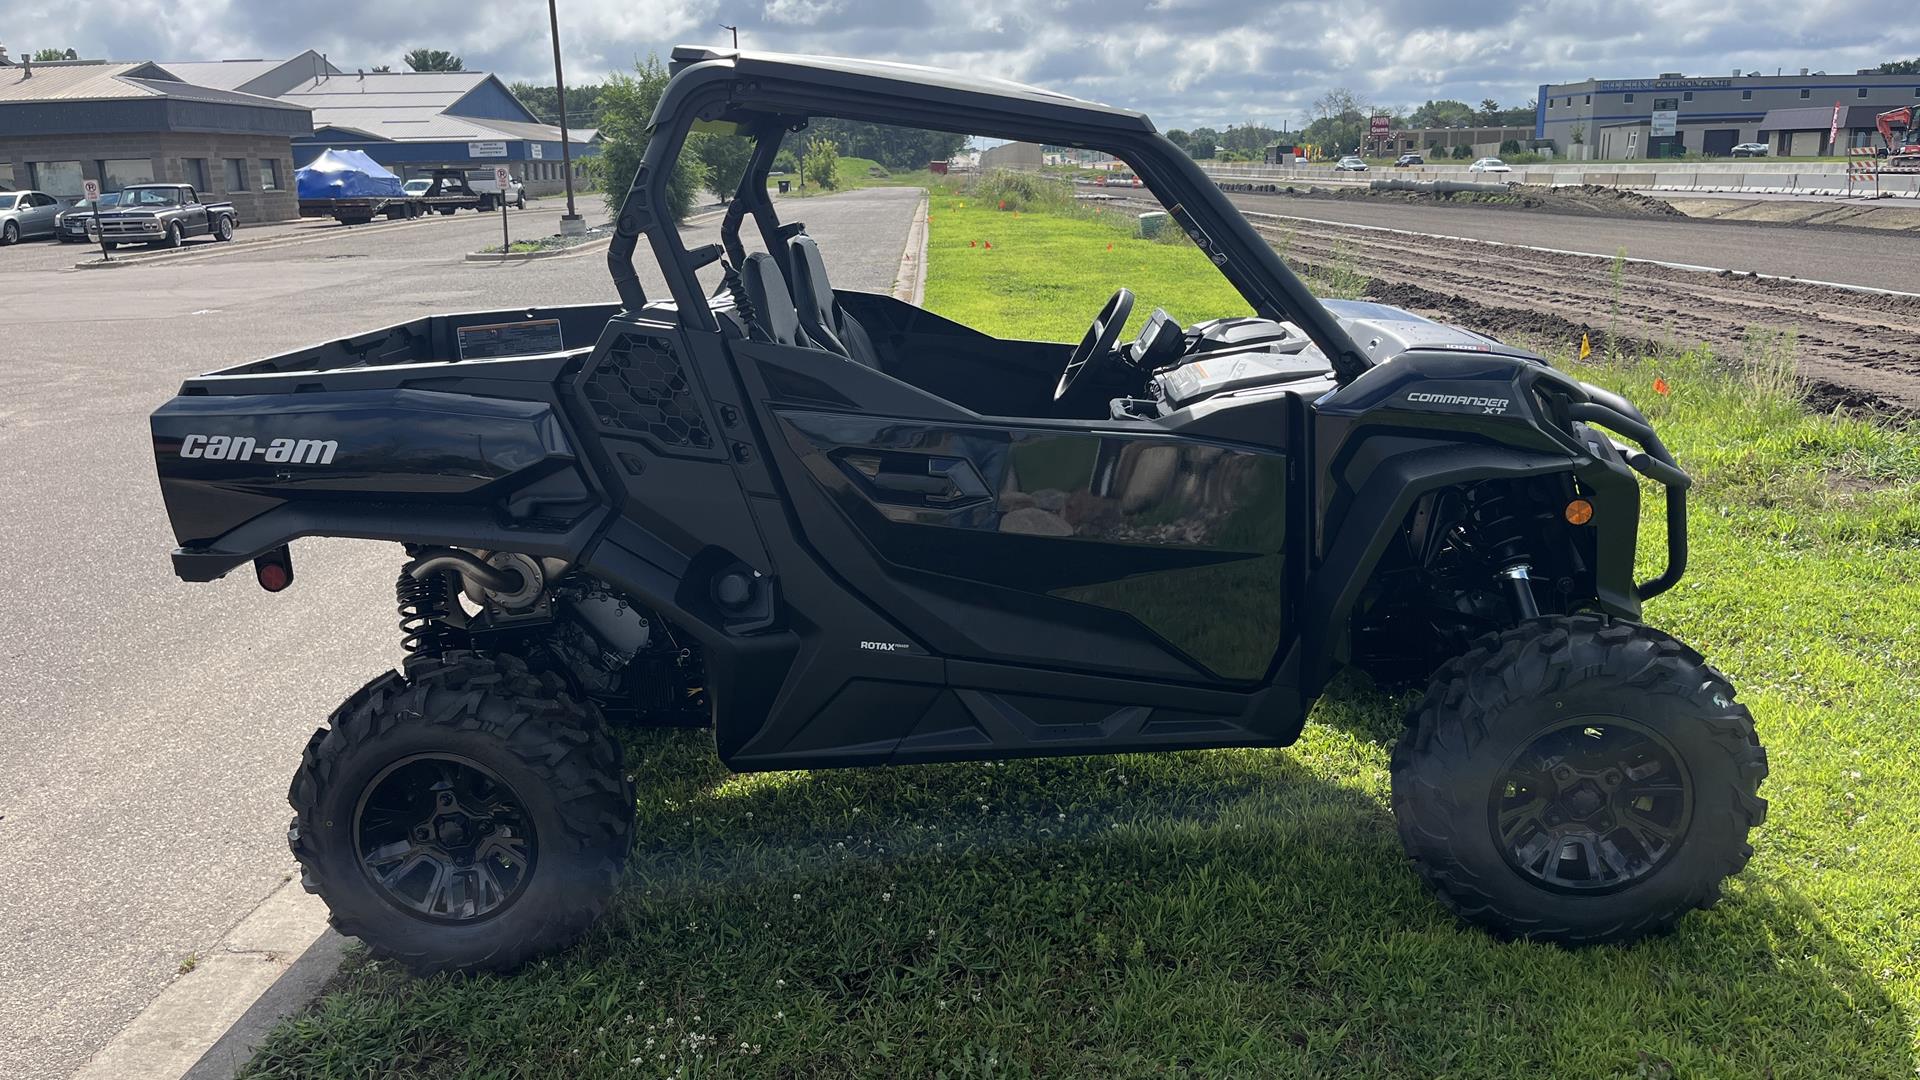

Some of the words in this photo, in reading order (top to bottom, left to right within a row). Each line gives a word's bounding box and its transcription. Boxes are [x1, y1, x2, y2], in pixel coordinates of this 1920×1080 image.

[1371, 117, 1389, 126] PAWN
[1407, 392, 1509, 408] COMMANDER
[1482, 406, 1506, 415] XT
[180, 434, 338, 465] can-am
[860, 641, 895, 651] ROTAX
